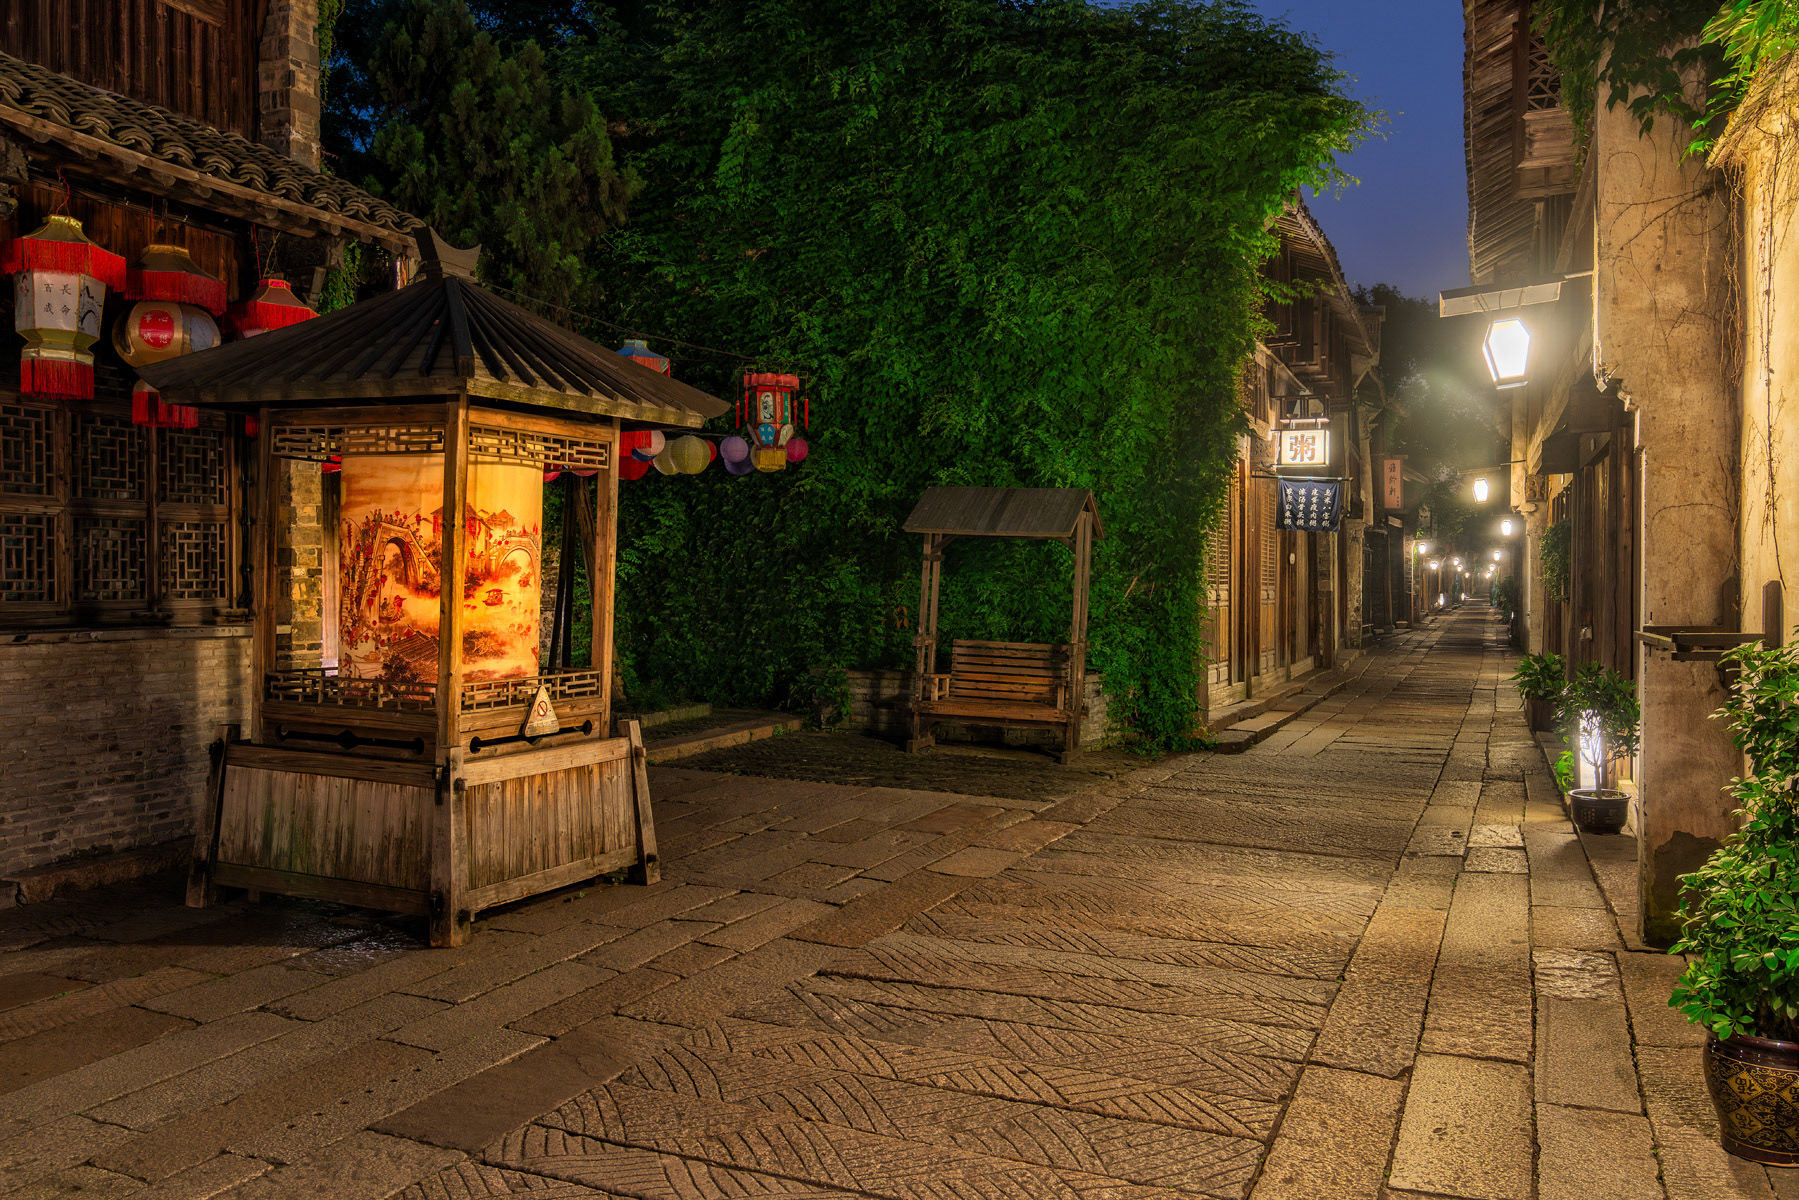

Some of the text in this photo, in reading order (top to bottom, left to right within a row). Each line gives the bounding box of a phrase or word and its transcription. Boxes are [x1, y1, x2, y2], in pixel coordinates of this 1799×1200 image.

[1289, 433, 1316, 462] 粥
[1309, 487, 1319, 527] 皮蛋瘦肉粥
